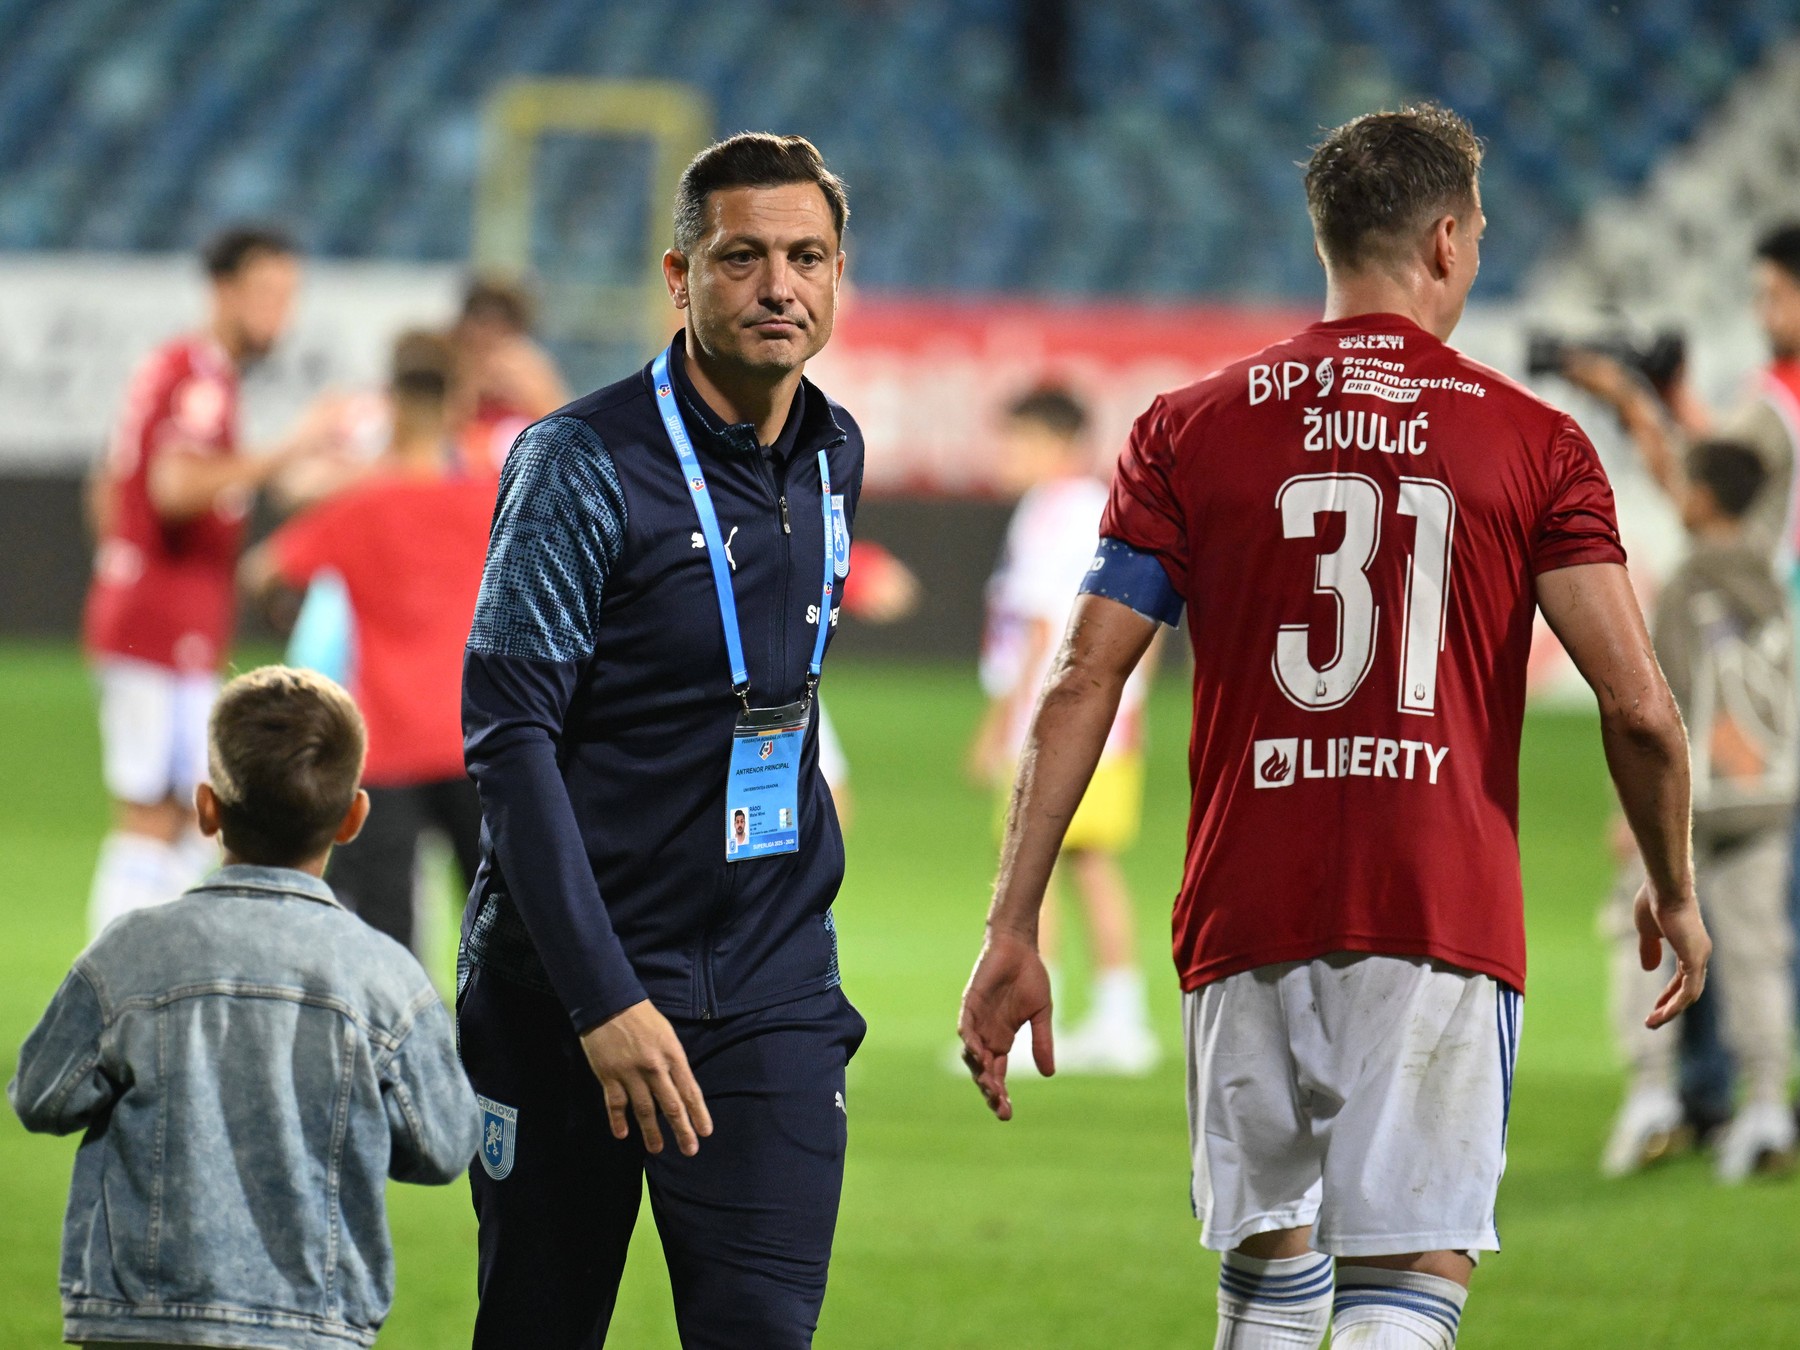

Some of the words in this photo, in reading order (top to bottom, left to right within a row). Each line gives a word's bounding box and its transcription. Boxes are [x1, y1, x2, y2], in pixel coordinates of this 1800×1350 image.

[1342, 356, 1405, 373] Balkan
[1342, 366, 1486, 398] Pharmaceuticals
[1347, 382, 1371, 391] PRO
[1373, 386, 1416, 400] HEALTH
[667, 415, 691, 457] SUPERLIGA
[1303, 407, 1429, 455] ŽIVULIĆ
[1271, 472, 1456, 716] 31
[736, 767, 763, 775] ANTRENOR
[1303, 736, 1449, 785] LIBERTY
[478, 1097, 515, 1119] CRAIOVA
